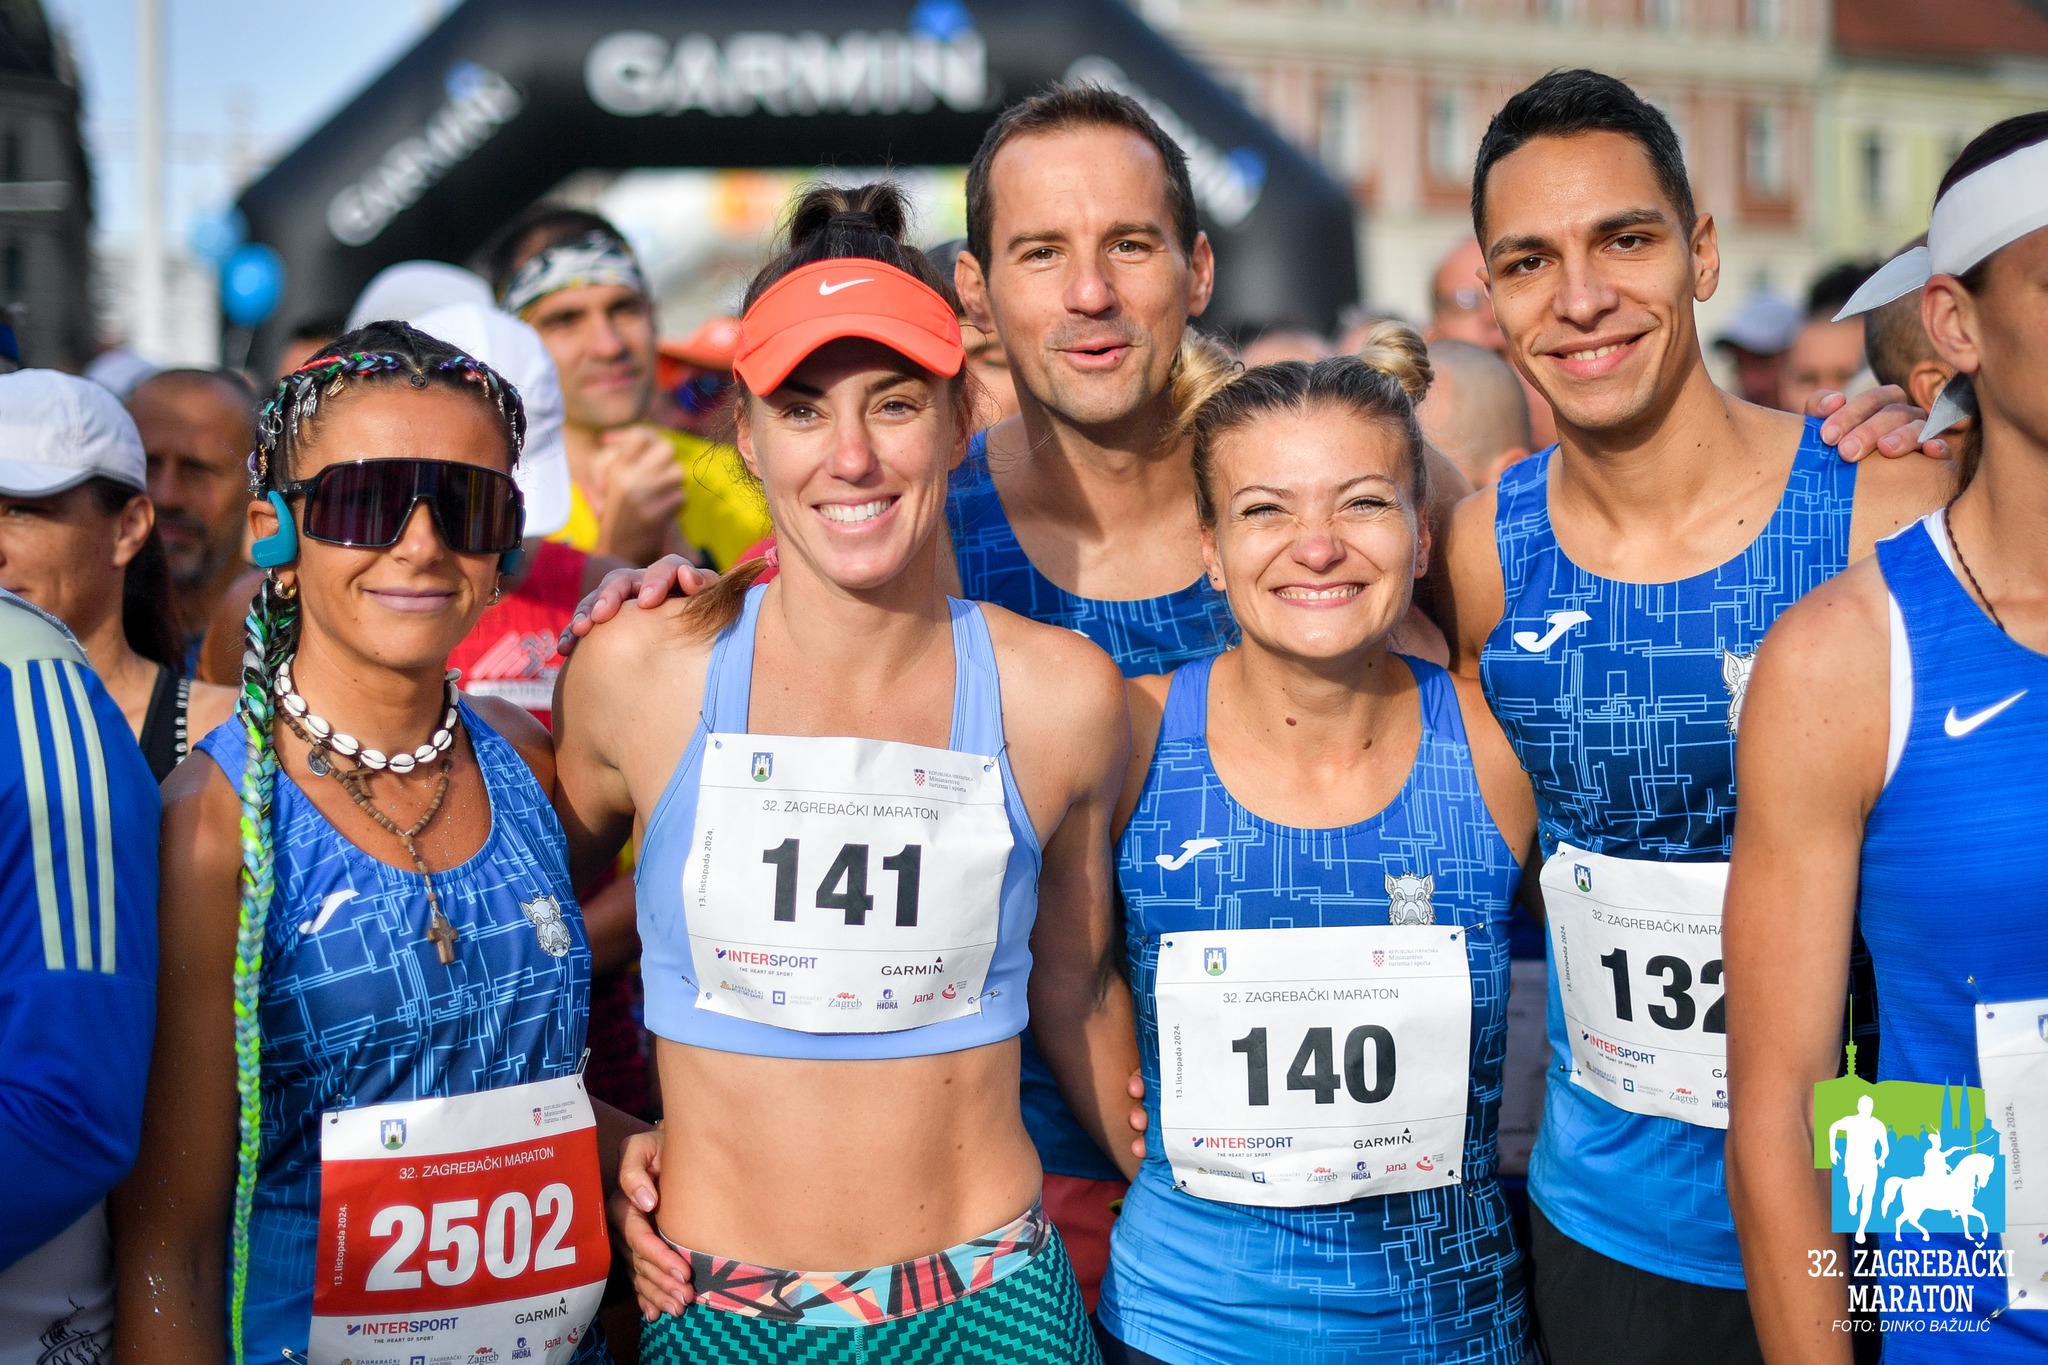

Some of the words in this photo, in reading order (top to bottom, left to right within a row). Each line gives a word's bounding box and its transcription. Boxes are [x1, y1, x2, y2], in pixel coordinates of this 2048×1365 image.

[584, 29, 987, 117] GARMIN
[928, 776, 960, 785] Ministarstvo
[928, 782, 948, 790] turizma
[762, 800, 780, 812] 32.
[784, 801, 868, 816] ZAGREBAČKI
[874, 807, 938, 820] MARATON
[704, 828, 714, 852] 2024.
[698, 853, 711, 894] listopada
[762, 838, 922, 926] 141
[698, 896, 706, 908] 13.
[1592, 909, 1605, 922] 32.
[1607, 914, 1684, 933] ZAGREBAČKI
[728, 950, 818, 969] INTERSPORT
[1563, 946, 1571, 980] listopada
[828, 998, 862, 1010] Zagreb
[1223, 992, 1241, 1003] 32.
[1245, 988, 1329, 1003] ZAGREBAČKI
[1334, 988, 1399, 1000] MARATON
[1590, 1034, 1656, 1064] INTERSPORT
[1175, 1047, 1183, 1085] listopada
[1232, 1024, 1396, 1106] 140
[1670, 1092, 1698, 1104] Zagreb
[2005, 1102, 2015, 1128] 2024.
[1206, 1136, 1293, 1148] INTERSPORT
[2008, 1131, 2020, 1175] listopada
[400, 1167, 418, 1179] 32.
[422, 1156, 502, 1178] ZAGREBAČKI
[505, 1146, 554, 1166] MARATON
[1306, 1172, 1338, 1183] Zagreb
[2014, 1176, 2022, 1190] 13.
[338, 1204, 347, 1228] 2024.
[365, 1182, 576, 1292] 2502
[335, 1230, 346, 1272] listopada
[334, 1272, 343, 1286] 13.
[363, 1317, 458, 1335] INTERSPORT
[467, 1352, 499, 1365] Zagreb
